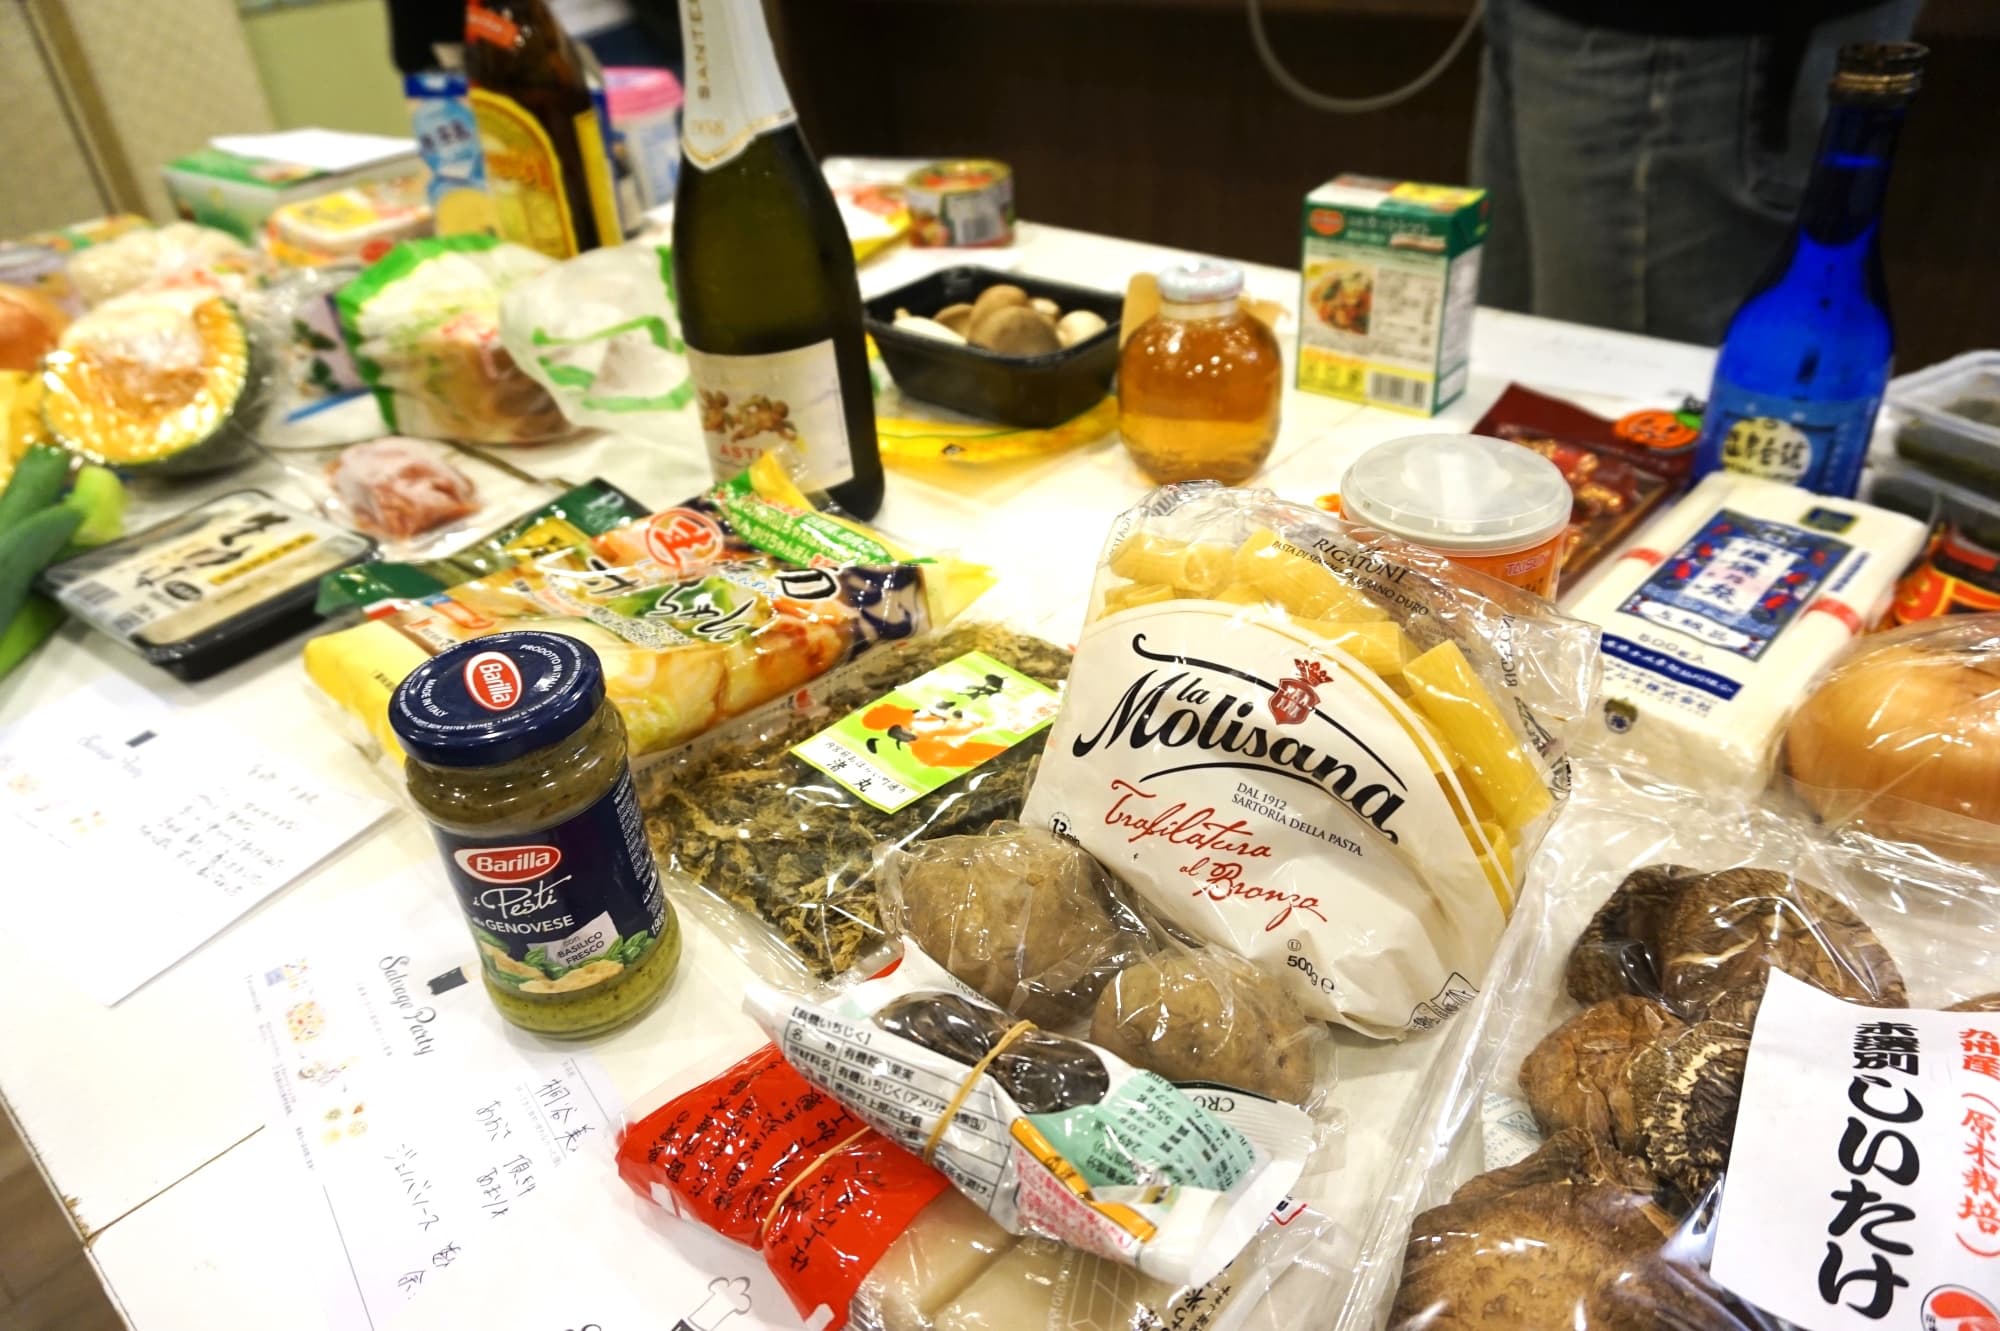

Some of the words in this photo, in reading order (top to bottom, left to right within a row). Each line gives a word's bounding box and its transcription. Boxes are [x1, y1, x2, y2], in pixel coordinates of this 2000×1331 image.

[1393, 592, 1430, 616] DURO
[421, 679, 437, 699] MADE
[480, 663, 515, 703] Barilla
[1178, 677, 1209, 706] la
[426, 702, 448, 718] ITALY
[1073, 668, 1404, 845] Molisana
[1236, 782, 1261, 800] DAL
[1262, 793, 1288, 811] 1912
[1104, 779, 1273, 858] Trafilatura
[1231, 793, 1287, 826] SARTORIA
[1288, 816, 1326, 841] DELLA
[476, 852, 550, 873] Barilla
[480, 874, 573, 919] Pesti
[485, 914, 575, 934] GENOVESE
[557, 931, 603, 959] BASILICO
[565, 940, 605, 964] FRESCO
[1286, 955, 1318, 985] 500g
[378, 955, 414, 1010] Salvage
[402, 1006, 437, 1057] Party
